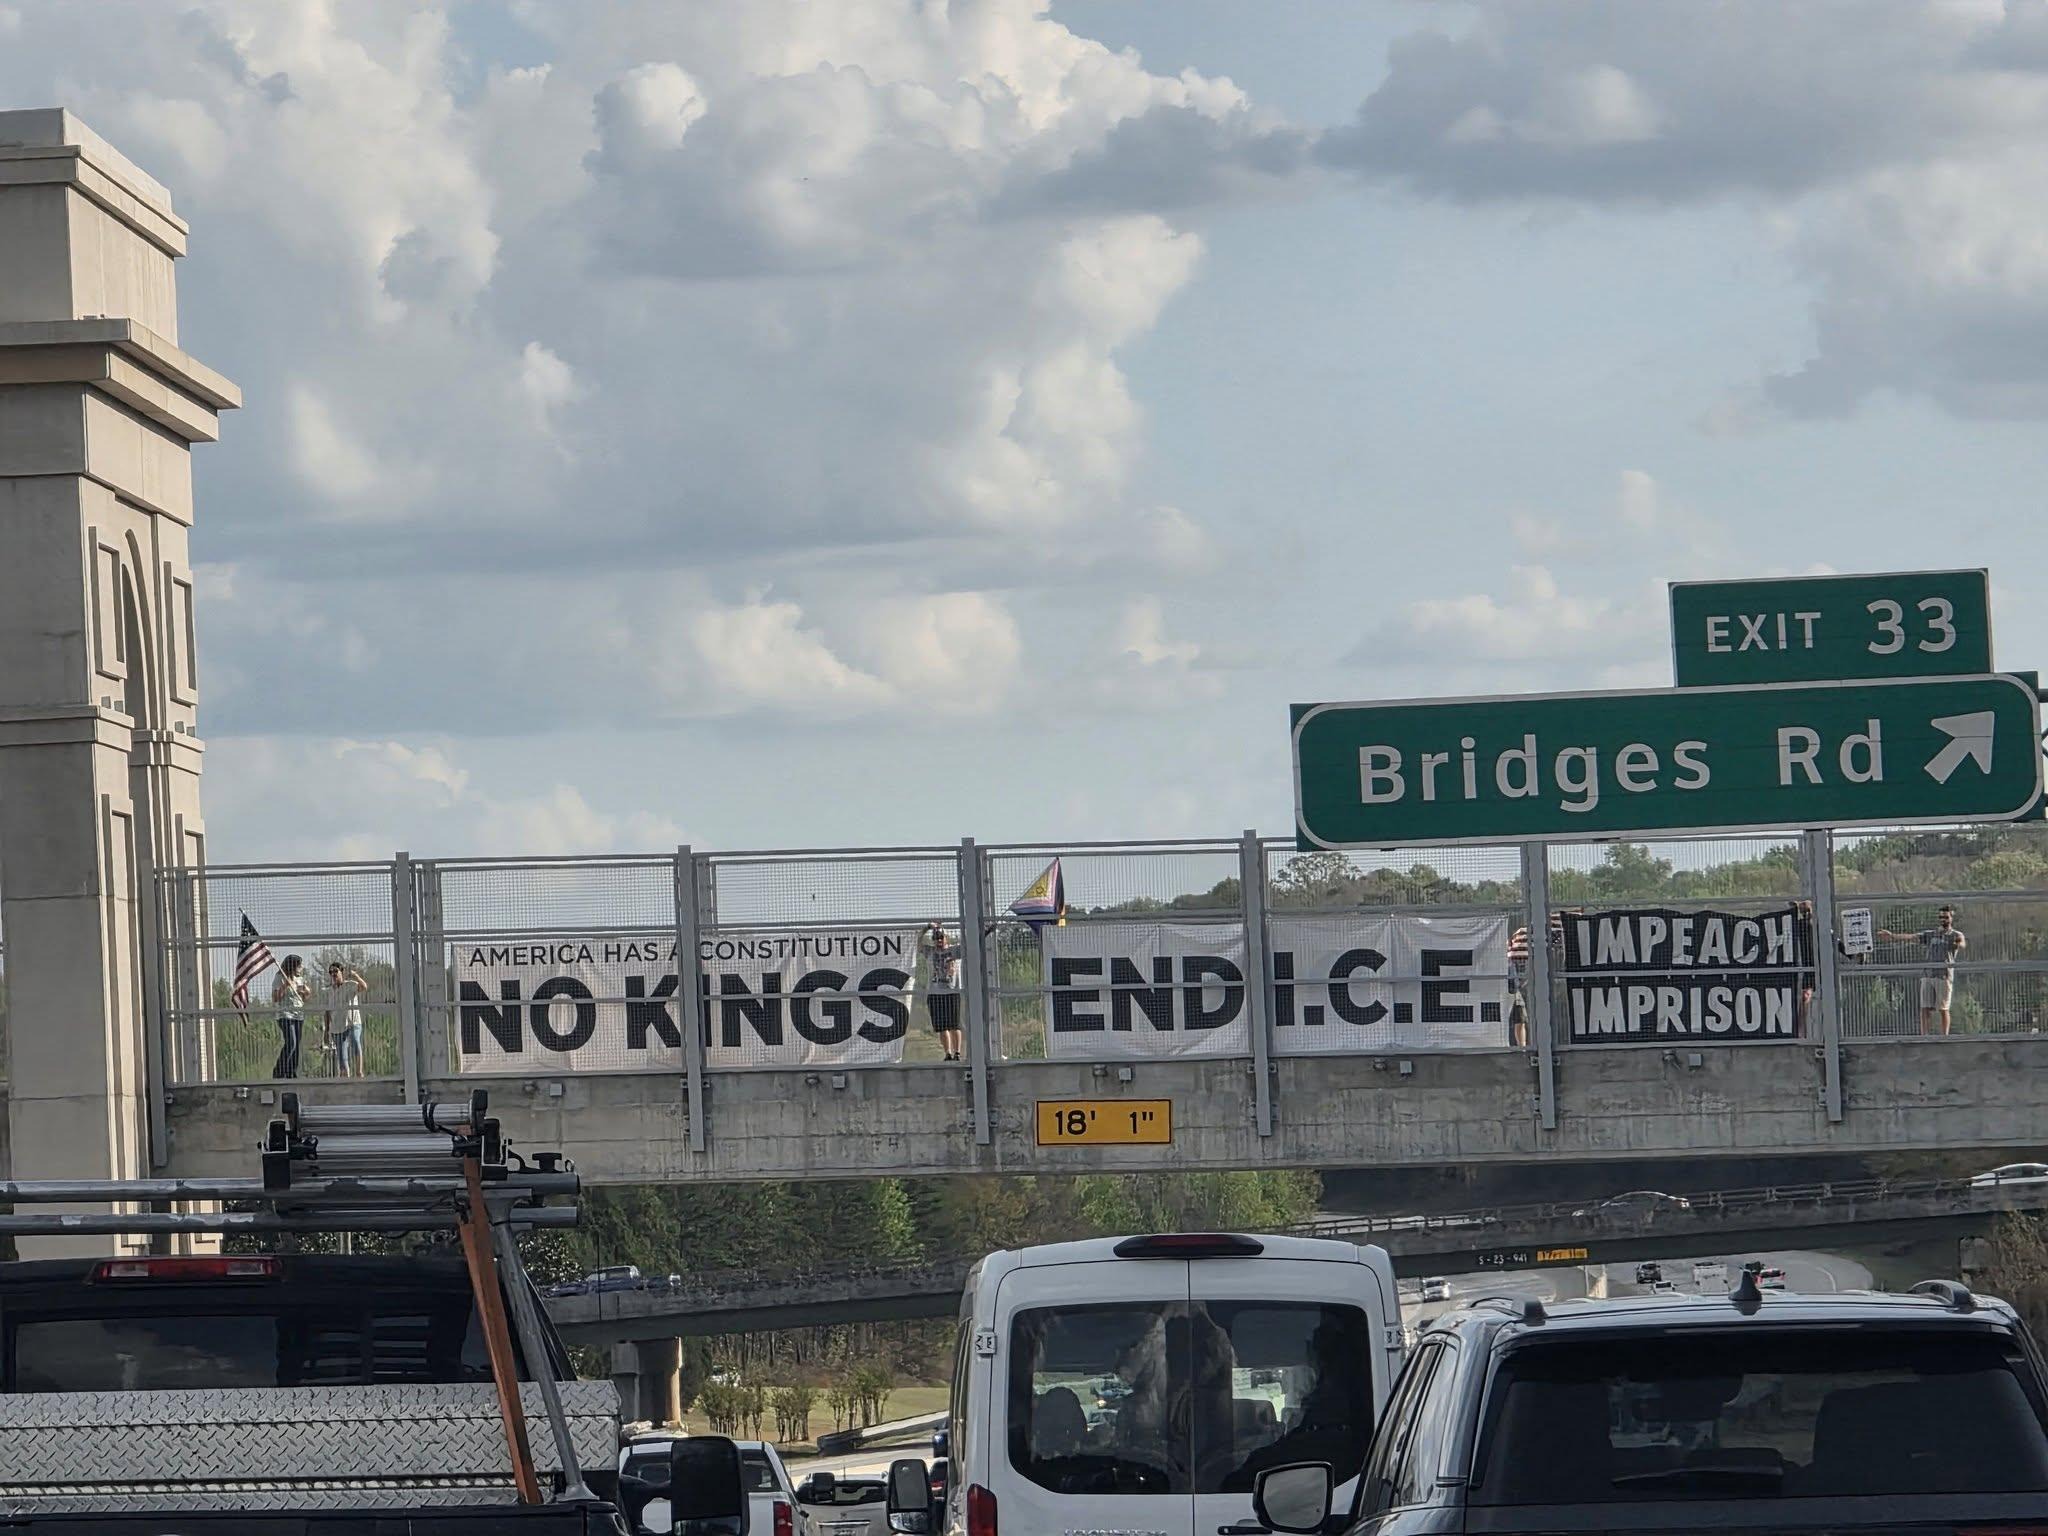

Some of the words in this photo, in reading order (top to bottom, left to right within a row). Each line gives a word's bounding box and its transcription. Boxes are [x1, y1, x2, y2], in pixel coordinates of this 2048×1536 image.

[1706, 611, 1822, 653] EXIT
[1866, 597, 1957, 655] 33
[1359, 734, 1711, 812] Bridges
[1777, 719, 1883, 785] Rd
[469, 944, 594, 967] AMERICA
[605, 942, 659, 962] HAS
[700, 936, 902, 961] CONSTITUTION
[1577, 914, 1794, 966] IMPEACH
[459, 976, 596, 1054] NO
[1051, 955, 1245, 1033] END
[1274, 948, 1501, 1027] I.C.E.
[1572, 985, 1793, 1035] IMPRISON
[1055, 1110, 1096, 1136] 18'
[1129, 1111, 1154, 1134] 1"
